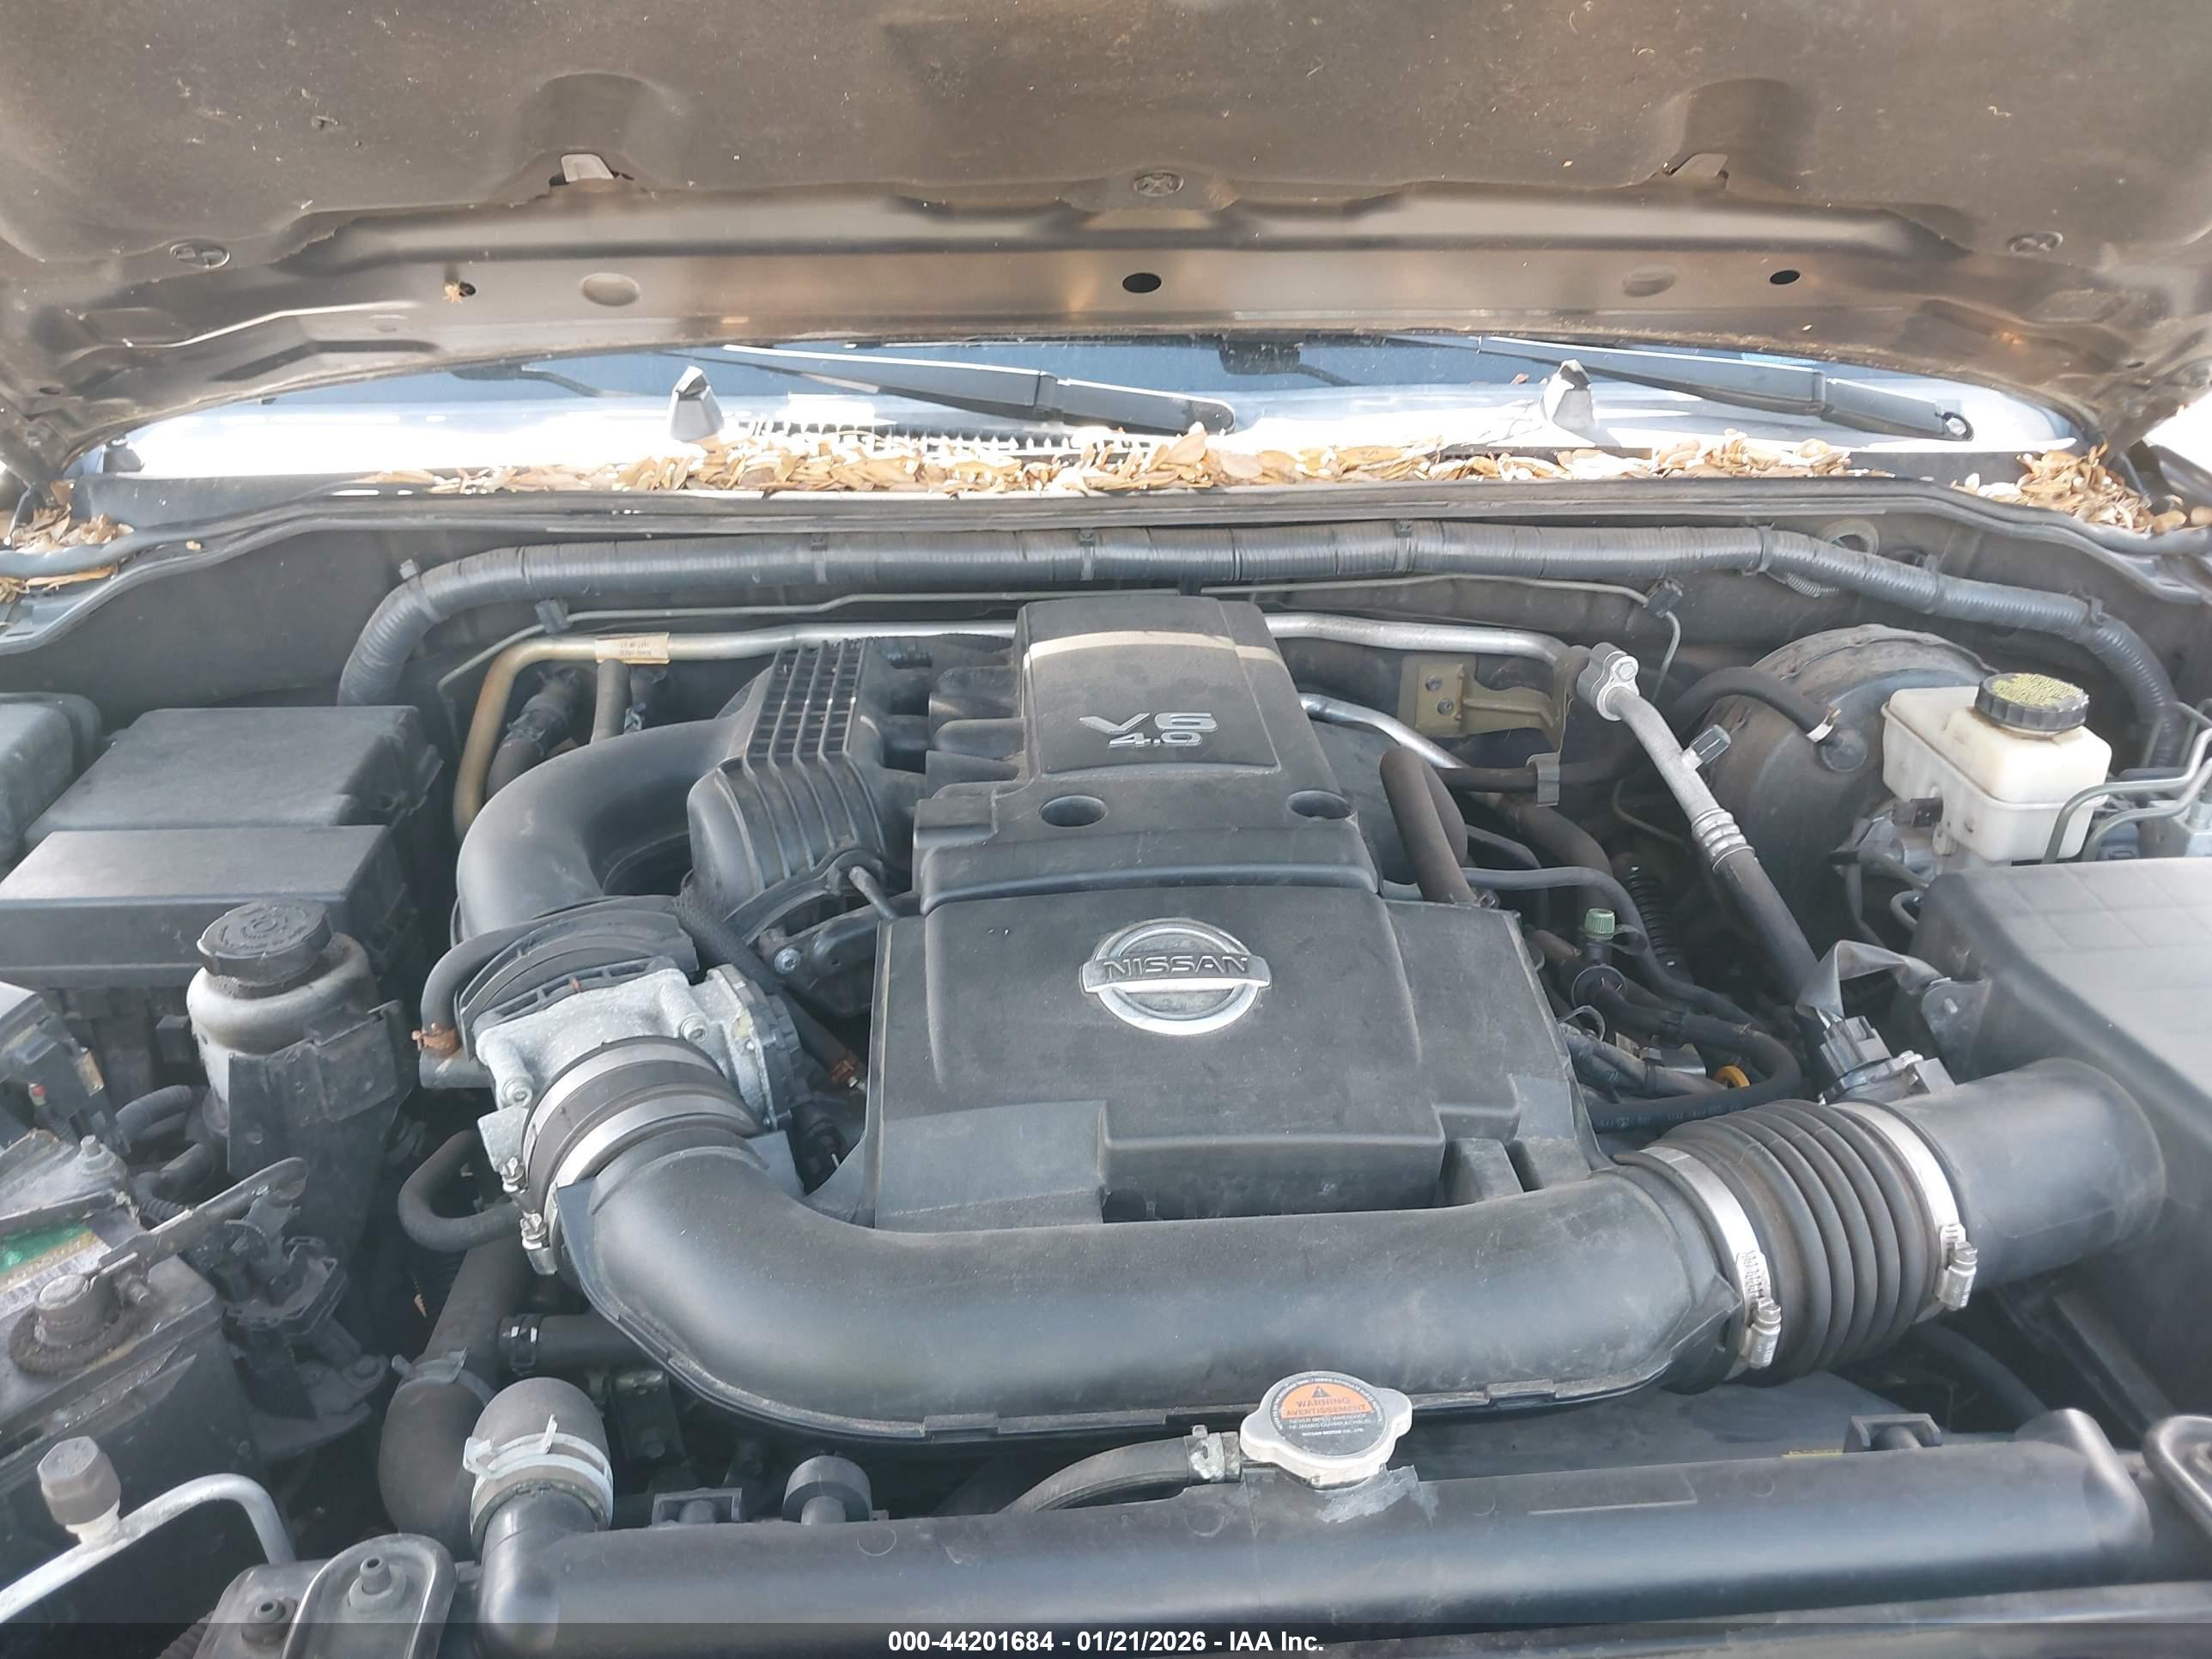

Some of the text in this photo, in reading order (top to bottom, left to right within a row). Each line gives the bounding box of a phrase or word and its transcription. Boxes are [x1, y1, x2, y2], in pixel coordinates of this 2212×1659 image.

[1079, 712, 1218, 734] V6
[1109, 732, 1201, 748] 4.0
[1103, 955, 1248, 979] NISSAN
[1286, 1404, 1366, 1416] AVERTISSEMENT
[1296, 1397, 1350, 1407] WARNING
